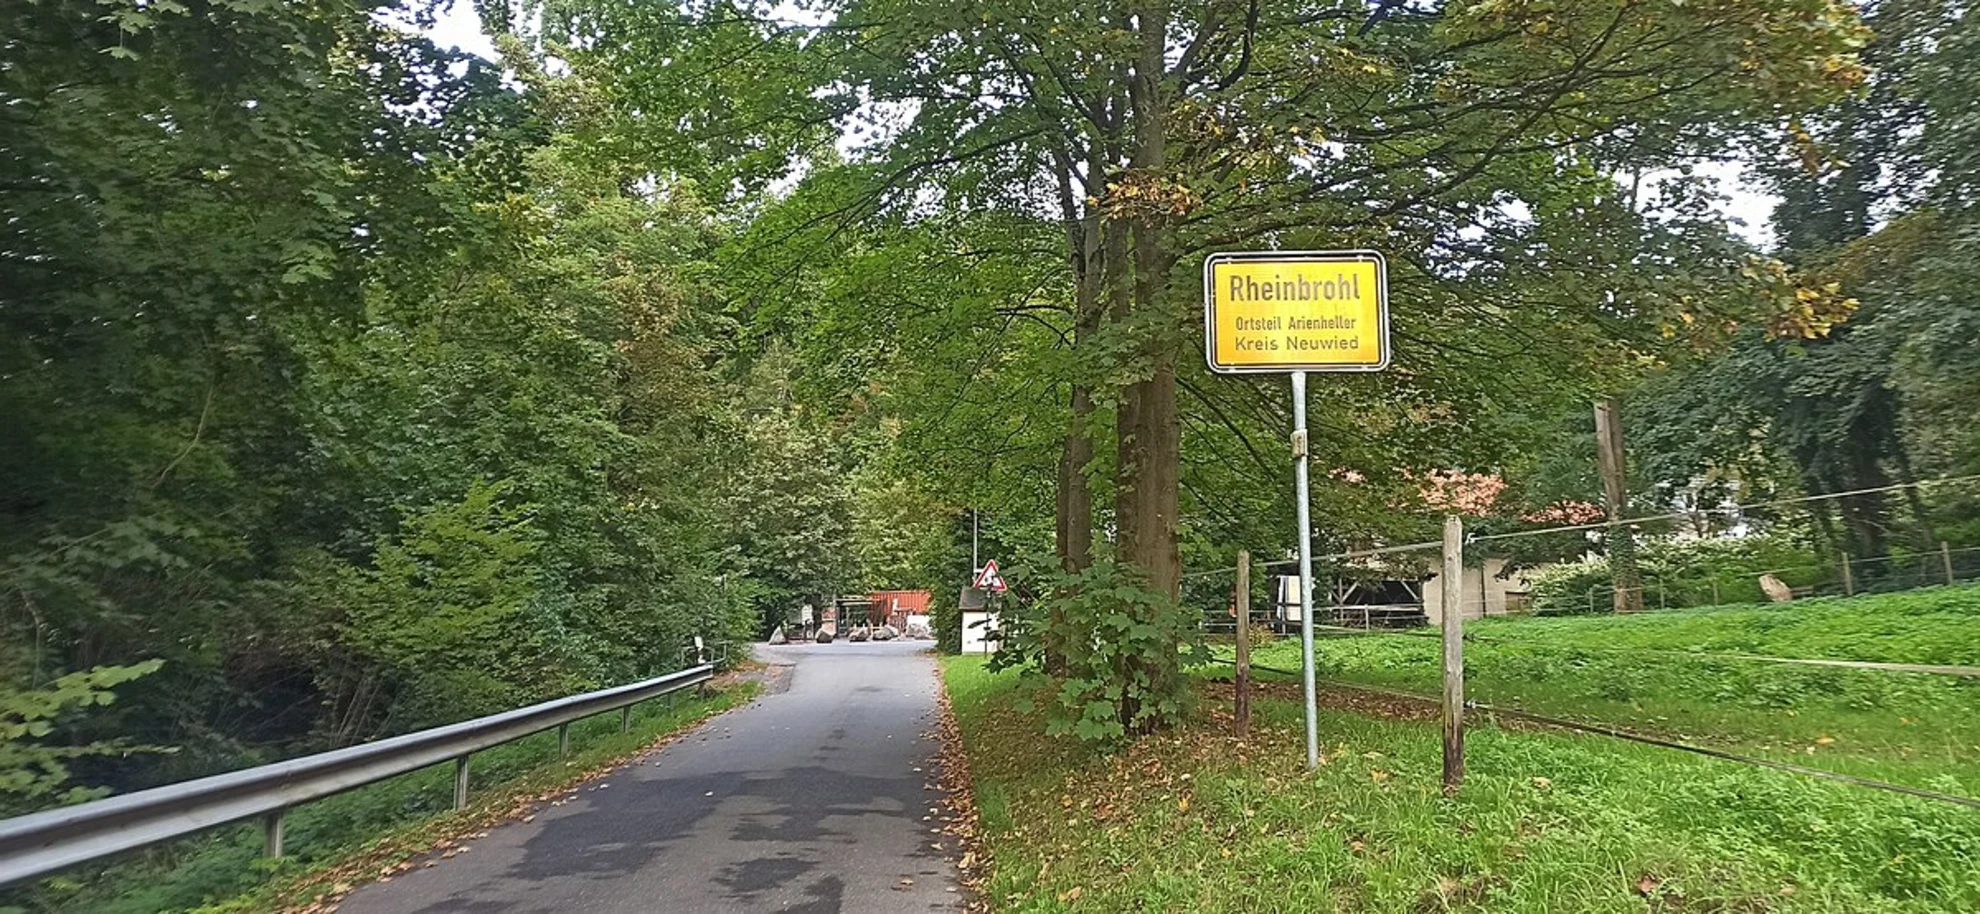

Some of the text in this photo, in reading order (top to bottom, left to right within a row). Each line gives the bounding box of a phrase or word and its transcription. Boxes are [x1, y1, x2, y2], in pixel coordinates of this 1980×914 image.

[1230, 274, 1360, 301] Rheinbrohl
[1236, 316, 1357, 331] Ortsteil Arienheller
[1235, 335, 1359, 351] Kreis Neuwied
